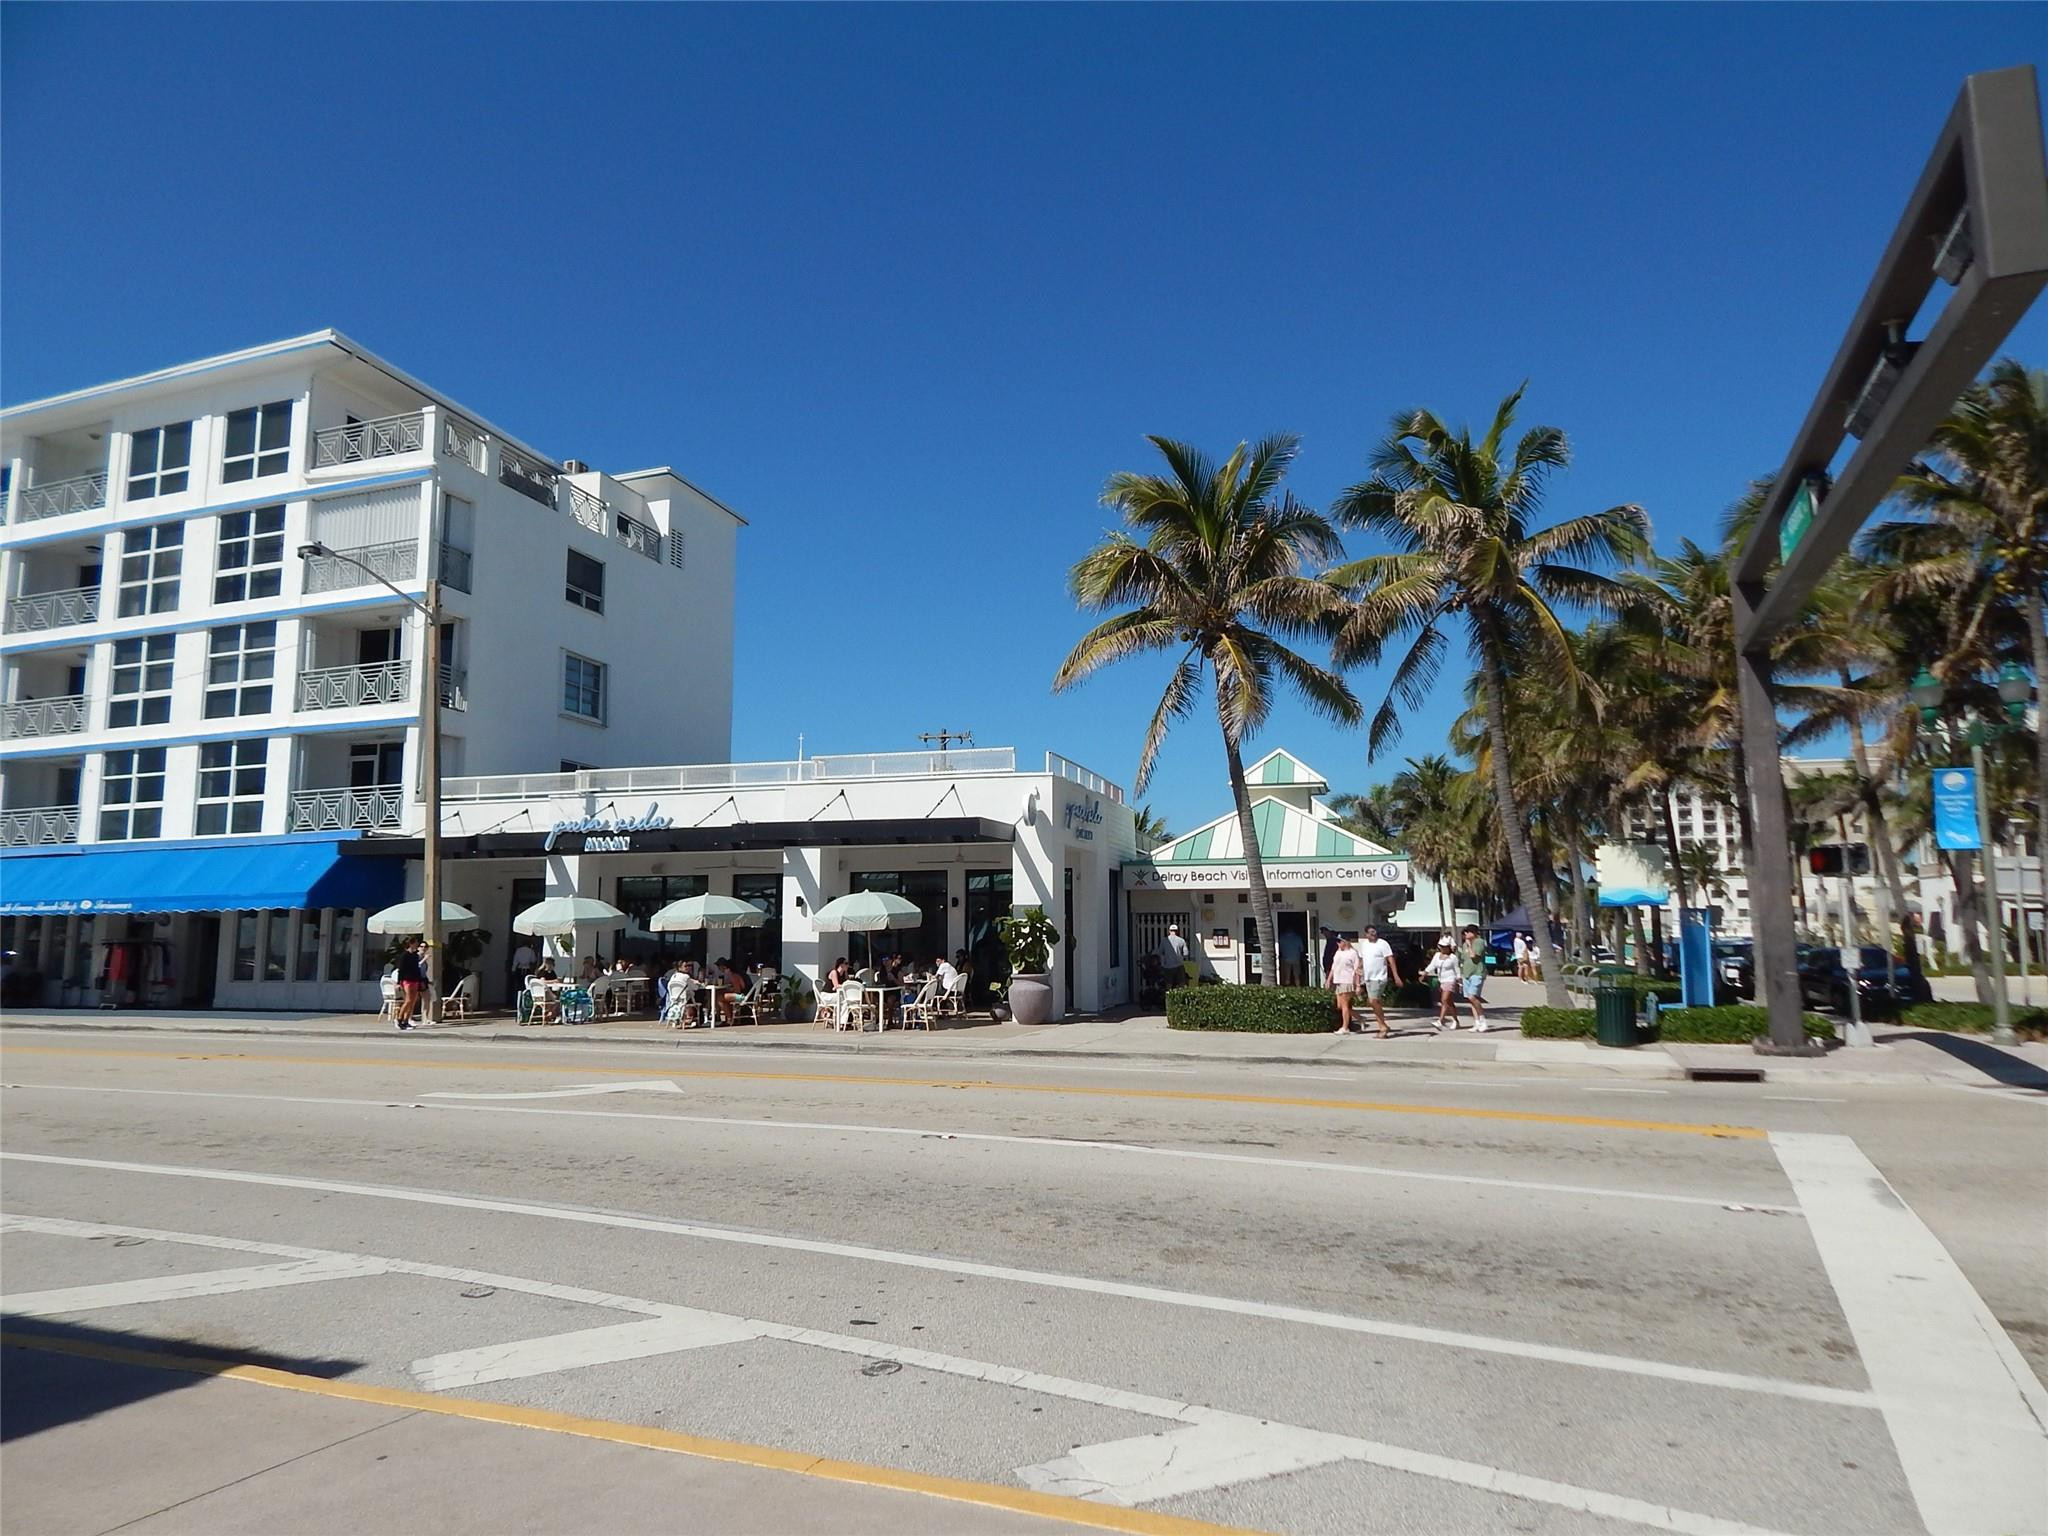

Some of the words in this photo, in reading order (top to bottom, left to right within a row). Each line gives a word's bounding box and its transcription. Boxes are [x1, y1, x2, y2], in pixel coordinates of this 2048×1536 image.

[614, 801, 673, 833] vida
[585, 836, 630, 851] MIAMI
[1152, 870, 1188, 883] Delray
[1191, 870, 1227, 881] Beach
[1266, 868, 1333, 880] Information
[1335, 867, 1377, 879] Center
